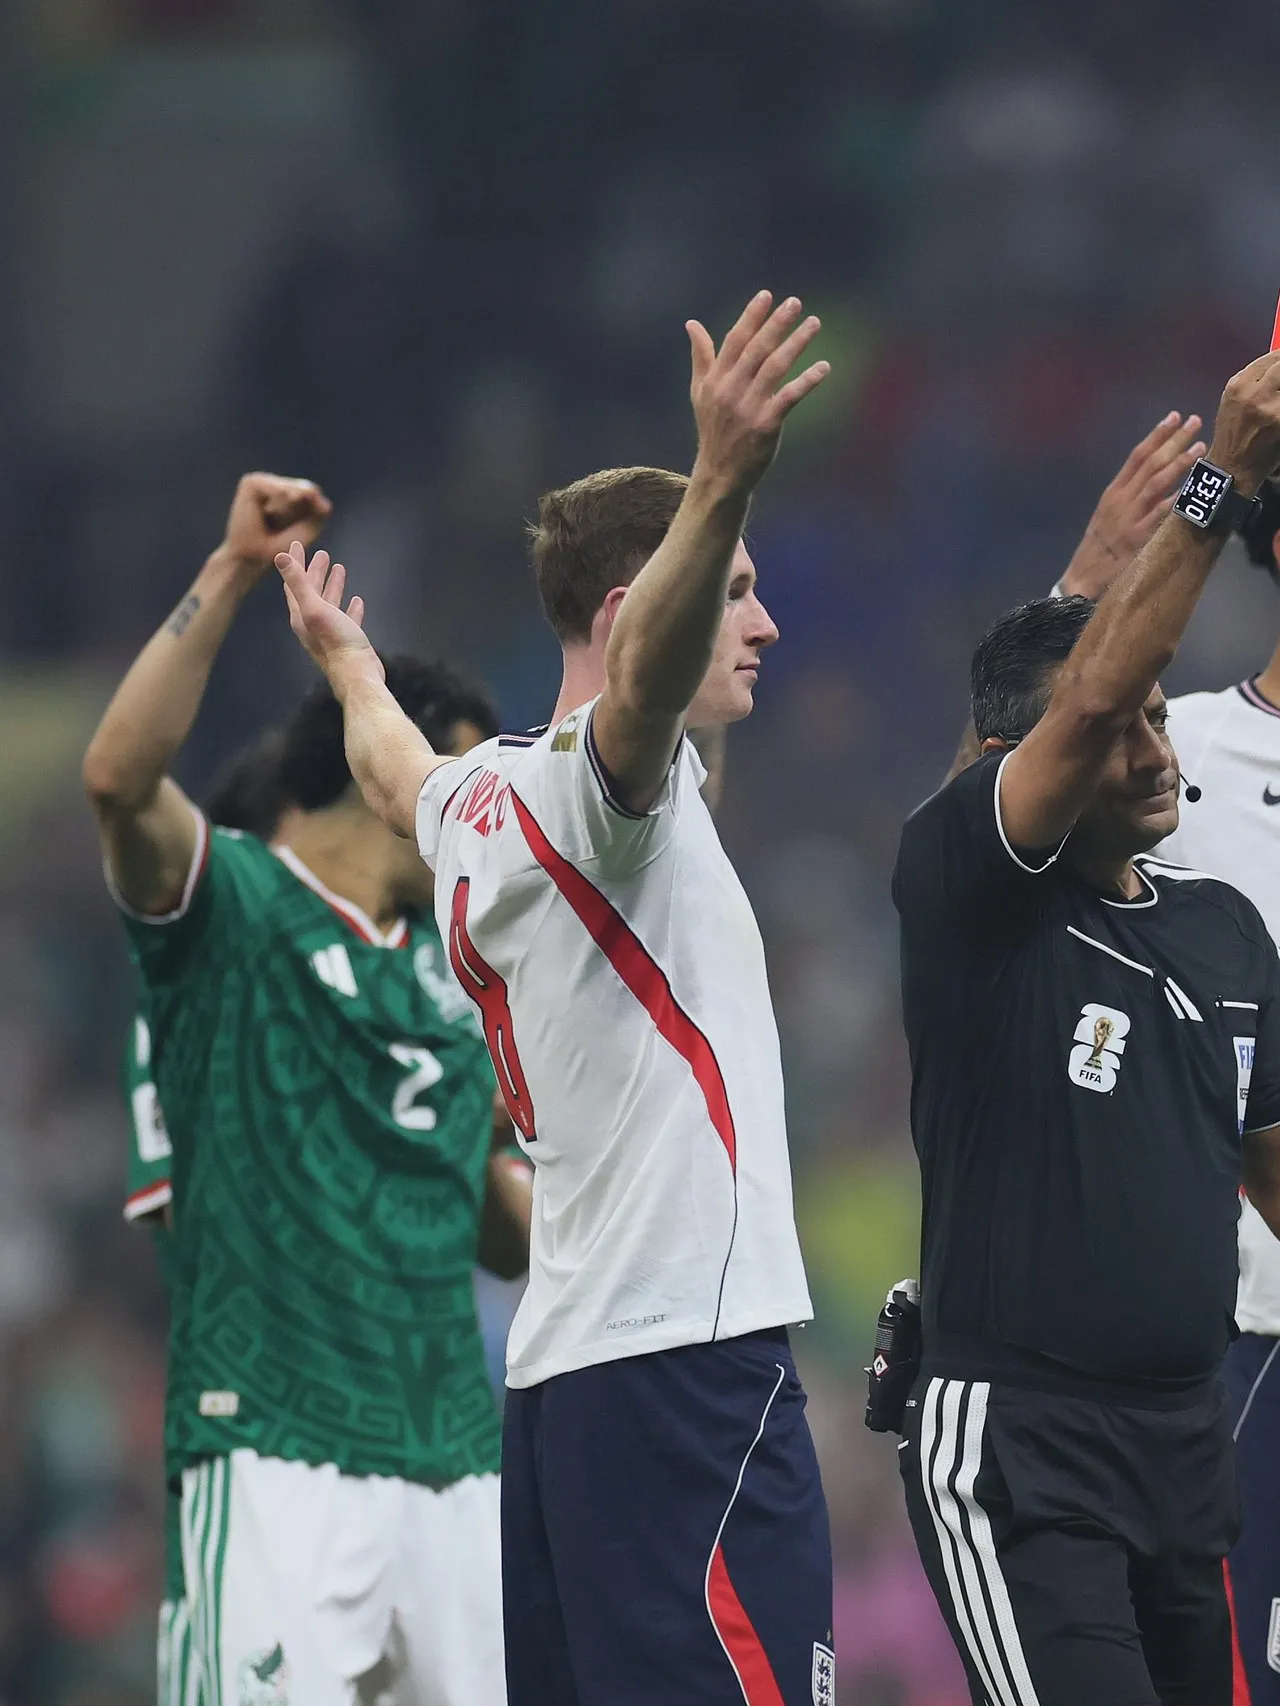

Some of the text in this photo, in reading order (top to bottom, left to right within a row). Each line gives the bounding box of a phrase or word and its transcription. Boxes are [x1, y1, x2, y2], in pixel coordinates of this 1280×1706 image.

[1185, 471, 1222, 521] 53:10
[387, 1042, 445, 1131] 2
[1079, 1069, 1102, 1084] FIFA
